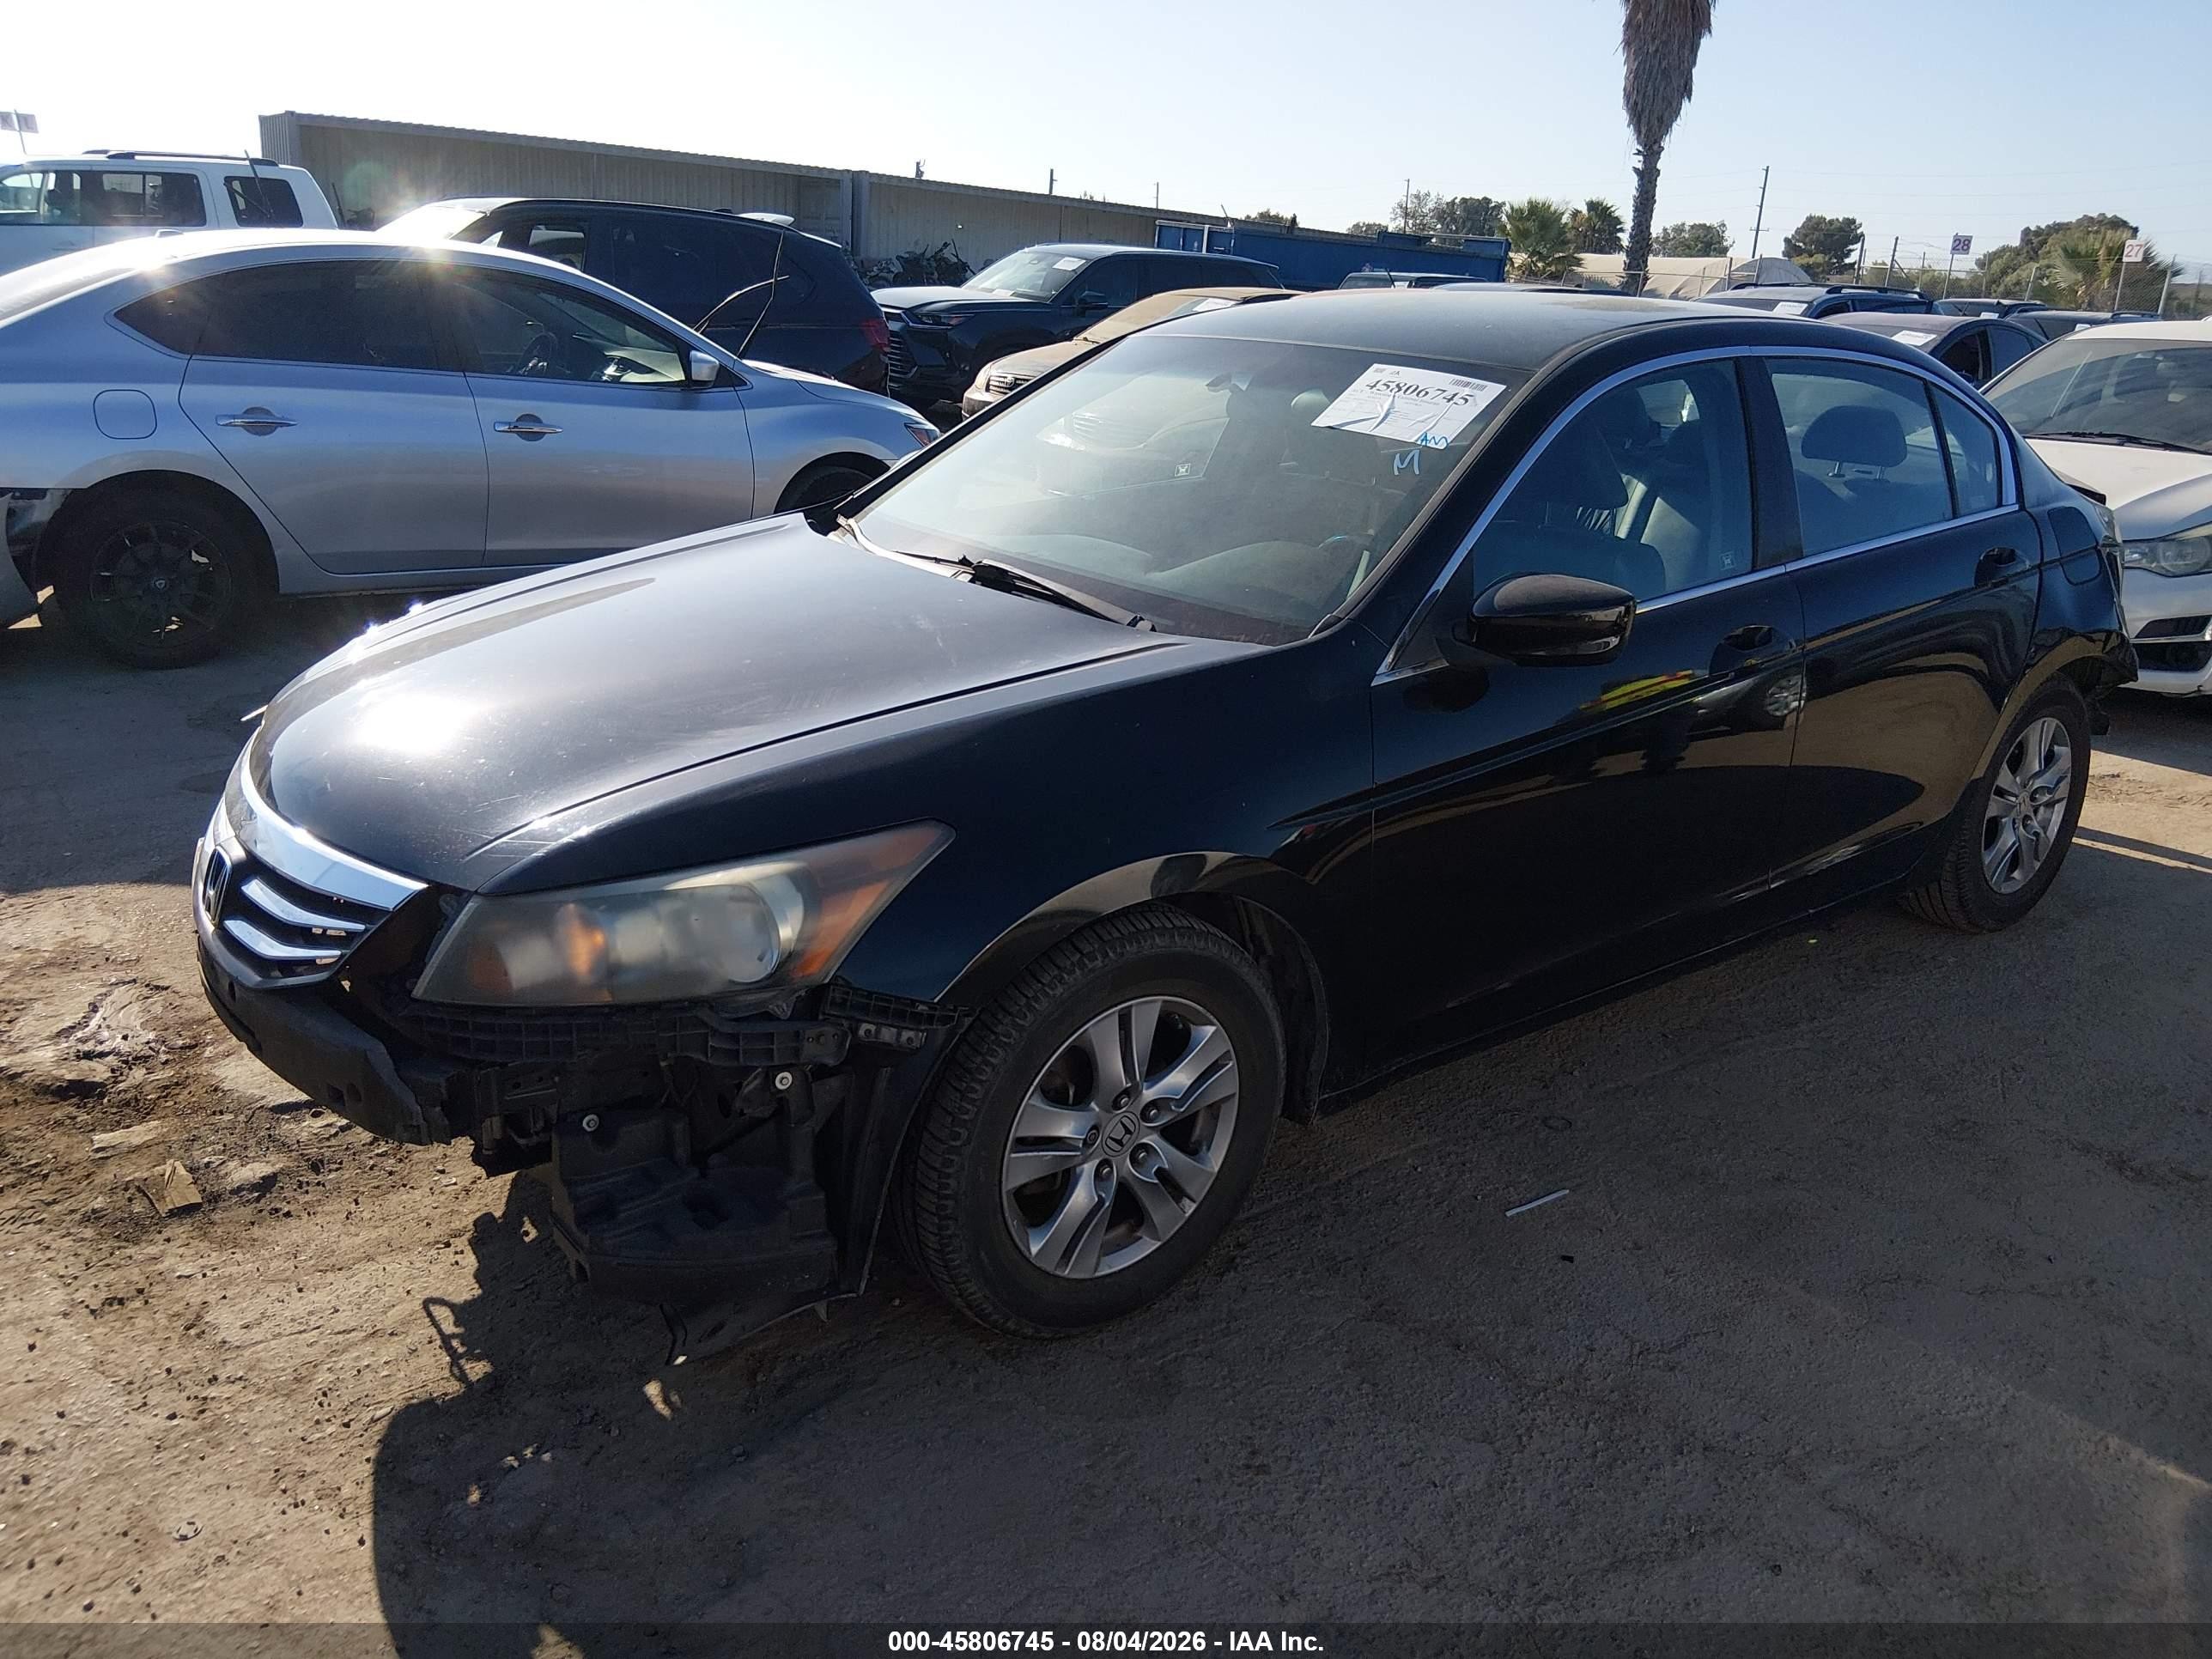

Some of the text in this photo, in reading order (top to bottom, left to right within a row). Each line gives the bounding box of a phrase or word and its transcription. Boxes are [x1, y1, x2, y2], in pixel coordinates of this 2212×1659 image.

[1952, 238, 1971, 252] 28
[2125, 243, 2144, 258] 27
[1365, 378, 1475, 407] 45806745
[1393, 449, 1420, 476] M
